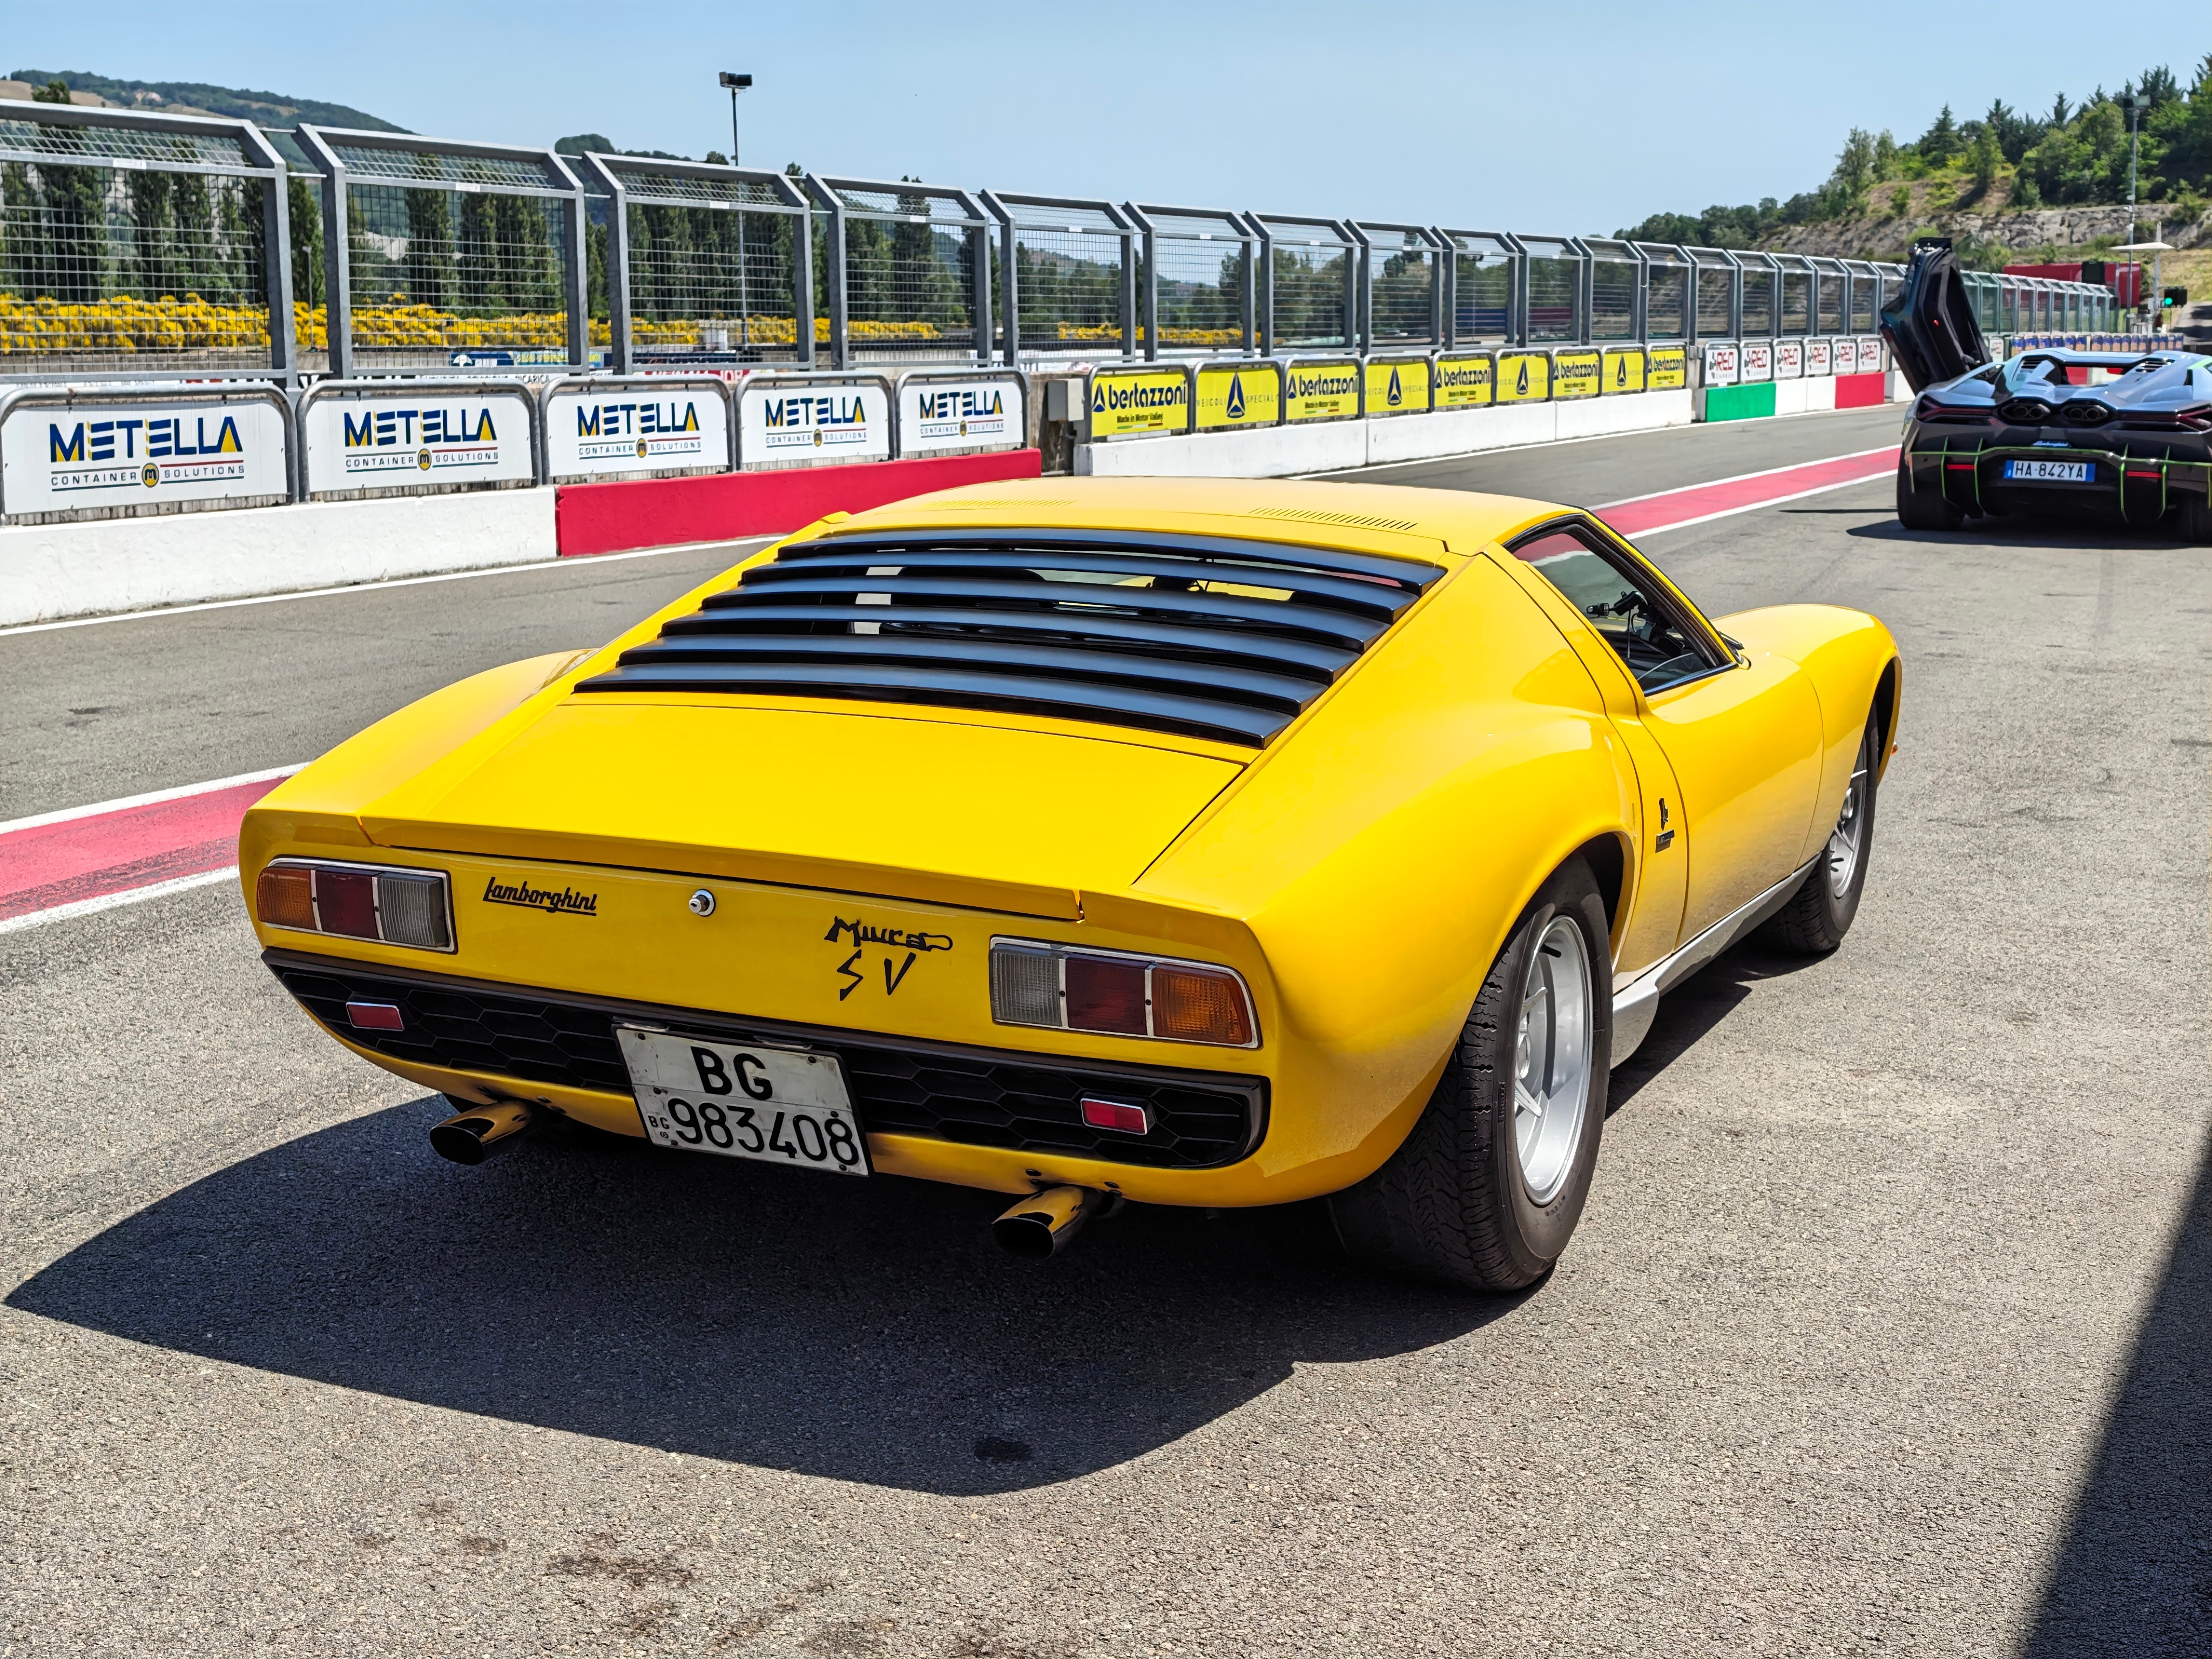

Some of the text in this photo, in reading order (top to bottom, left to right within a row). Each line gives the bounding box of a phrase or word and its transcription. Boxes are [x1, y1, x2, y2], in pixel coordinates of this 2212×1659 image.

[920, 390, 1003, 419] METELLA
[1109, 380, 1187, 410] bertazzoni
[577, 402, 699, 437] METELLA
[765, 396, 866, 427] METELLA
[50, 416, 242, 463] METELLA
[344, 408, 497, 447] METELLA
[346, 456, 414, 467] CONTAINER
[435, 451, 498, 463] SOLUTIONS
[579, 441, 701, 455] CONTAINER SOLUTIONS
[51, 471, 137, 486] CONTAINER
[164, 465, 245, 478] SOLUTIONS
[2015, 462, 2032, 477] HA
[2038, 463, 2083, 479] 842YA
[483, 876, 597, 916] Lamborghini
[824, 916, 953, 952] Miura
[690, 1046, 773, 1101] BG
[648, 1115, 670, 1129] BG
[667, 1097, 860, 1166] 983408
